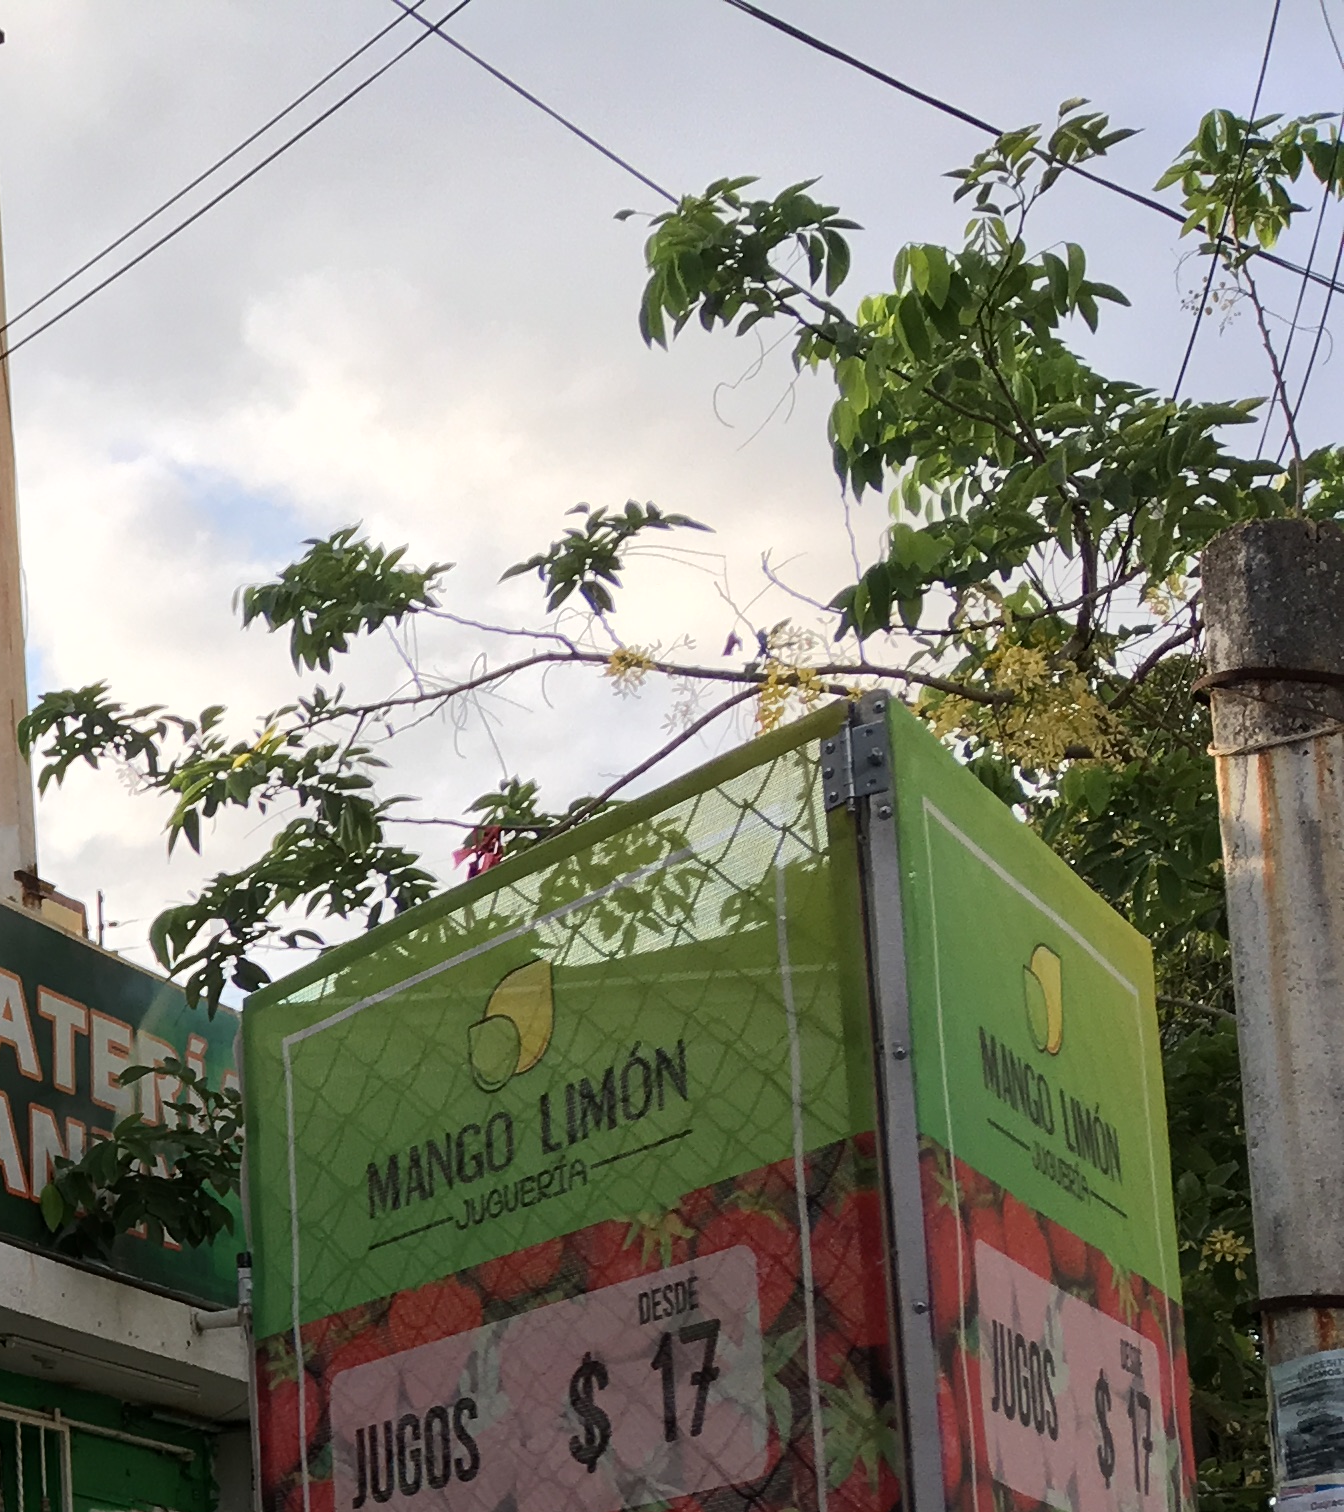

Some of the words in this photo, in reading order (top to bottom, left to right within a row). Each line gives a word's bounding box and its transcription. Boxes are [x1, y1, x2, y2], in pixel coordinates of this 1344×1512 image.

[365, 1112, 514, 1220] MANGO
[539, 1038, 691, 1155] LIMÓN
[979, 1026, 1056, 1136] MANGO
[1059, 1087, 1124, 1186] LIMÓN
[455, 1155, 589, 1232] JUGUERÍA
[638, 1276, 701, 1326] DESDE
[990, 1318, 1059, 1443] JUGOS
[353, 1397, 482, 1510] JUGOS
